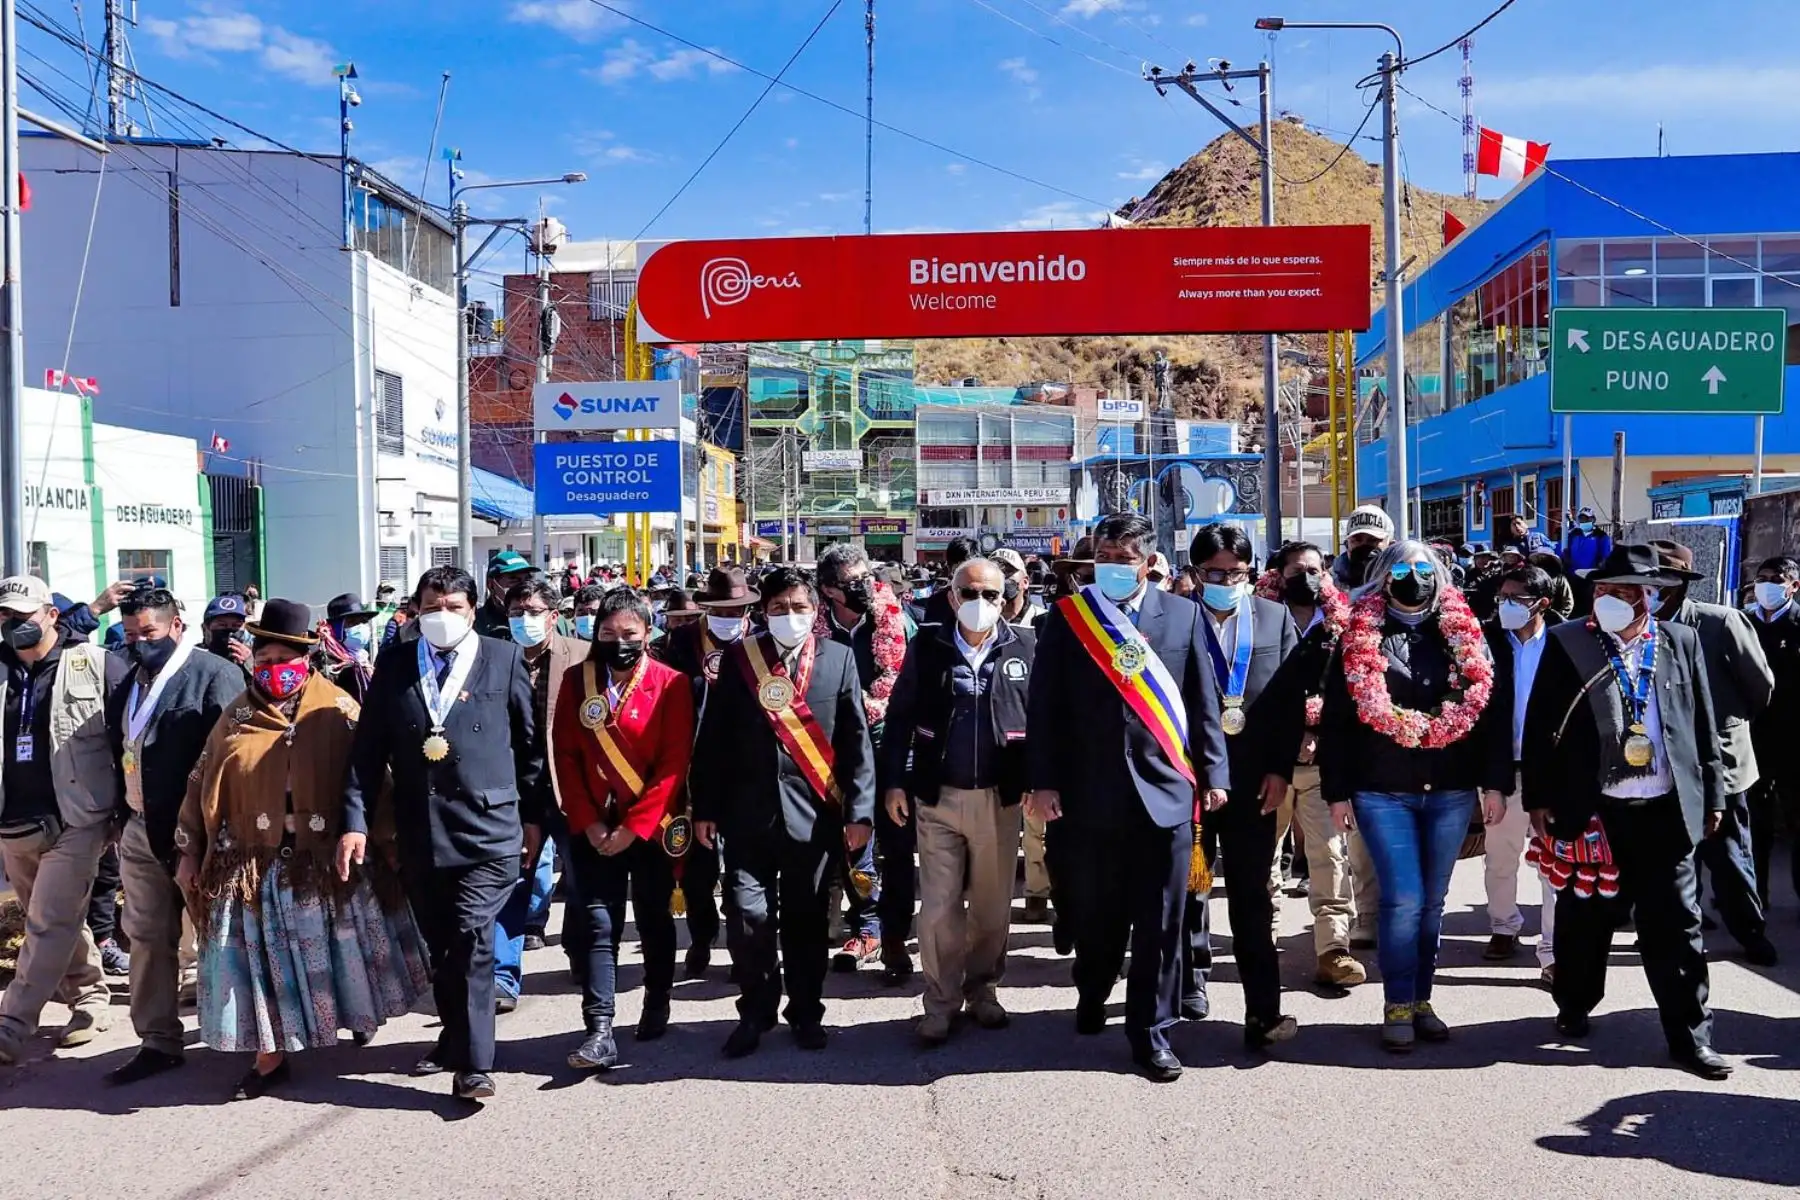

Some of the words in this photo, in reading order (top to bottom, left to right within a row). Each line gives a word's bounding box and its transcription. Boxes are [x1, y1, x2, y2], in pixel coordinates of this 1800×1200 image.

[1173, 256, 1213, 267] Siempre
[1214, 255, 1235, 265] más
[1237, 256, 1249, 265] de
[1251, 256, 1261, 265] lo
[1262, 256, 1281, 266] que
[1283, 255, 1323, 265] esperas.
[910, 255, 1086, 284] Bienvenido
[701, 257, 802, 319] Perú
[1178, 289, 1214, 300] Always
[1215, 290, 1241, 298] more
[1243, 288, 1266, 298] than
[1267, 289, 1286, 299] you
[1288, 288, 1323, 299] expect.
[909, 292, 997, 310] Welcome
[1602, 330, 1775, 352] DESAGUADERO
[1606, 370, 1669, 390] PUNO
[580, 397, 660, 413] SUNAT
[556, 454, 628, 469] PUESTO
[634, 453, 659, 467] DE
[563, 470, 653, 485] CONTROL
[566, 490, 650, 502] Desaguadero
[945, 491, 962, 499] DXN
[963, 490, 1021, 499] INTERNATIONAL
[1024, 489, 1044, 497] PERU
[117, 505, 192, 525] DESAGUADERO
[1351, 513, 1383, 528] POLICIA
[3, 582, 29, 597] ICIA
